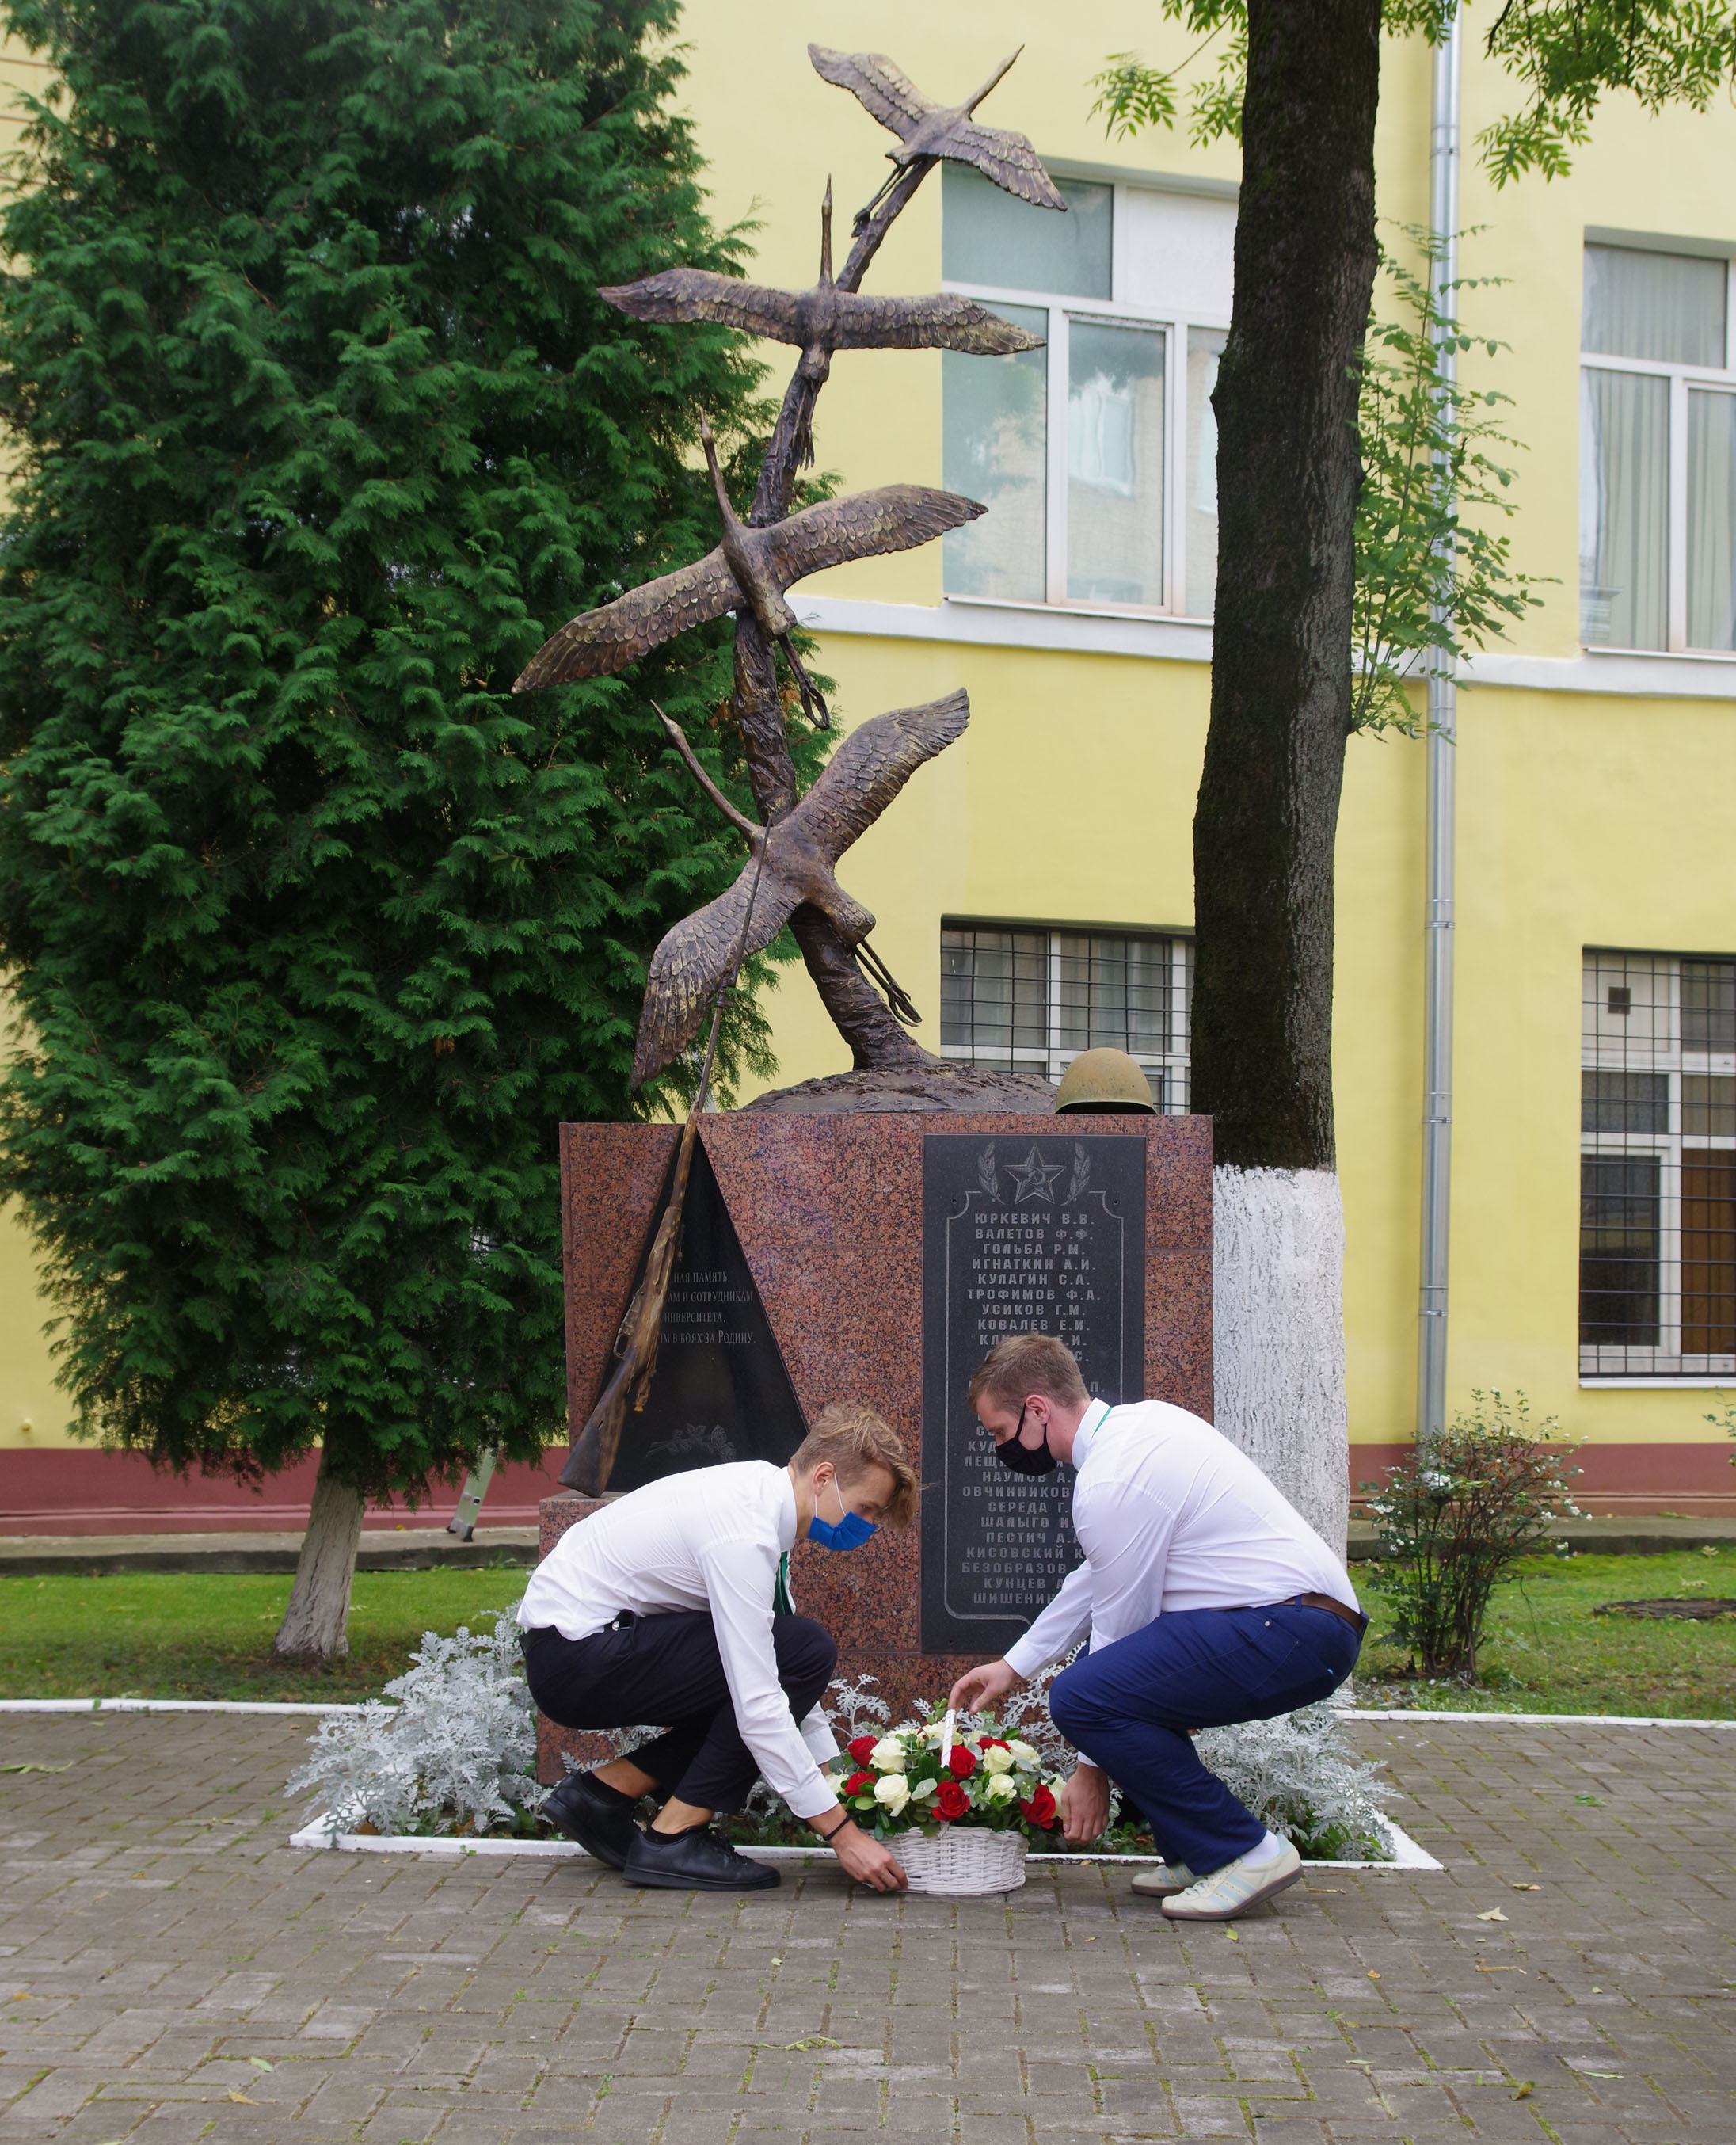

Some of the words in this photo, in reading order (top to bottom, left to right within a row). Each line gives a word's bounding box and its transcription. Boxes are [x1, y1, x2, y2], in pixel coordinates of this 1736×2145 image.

[975, 1213, 1051, 1224] ЮРКЕВИЧ
[1062, 1213, 1095, 1225] В.В.
[975, 1229, 1045, 1240] ВАЛЕТОВ
[1056, 1229, 1094, 1240] Ф.Ф.
[983, 1244, 1043, 1255] ГОЛЬБА
[1054, 1244, 1085, 1255] Р.М.
[973, 1259, 1053, 1269] ИГНАТКИН
[1064, 1259, 1096, 1270] А.И.
[692, 1271, 728, 1282] ПАМЯТЬ
[978, 1274, 1048, 1285] КУЛАГИН
[1059, 1274, 1091, 1285] С.А.
[691, 1290, 753, 1303] СОТРУДНИКАМ
[967, 1289, 1056, 1300] ТРОФИМОВ
[1066, 1289, 1101, 1301] Ф.А.
[982, 1304, 1045, 1315] УСИКОВ
[1056, 1304, 1086, 1316] Г.М.
[977, 1319, 1049, 1331] КОВАЛЕВ
[1059, 1320, 1091, 1331] Е.И.
[680, 1332, 702, 1343] БОЯХ
[704, 1332, 715, 1343] ЗА
[982, 1471, 1046, 1482] НАУМОВ
[962, 1486, 1070, 1498] ОВЧИННИКОВ
[988, 1502, 1048, 1514] СЕРЕДА
[981, 1517, 1049, 1528] ШАЛЫГО
[986, 1532, 1046, 1543] ПЕСТИЧ
[966, 1545, 1064, 1559] КИСОВСКИЙ
[961, 1562, 1067, 1574] БЕЗОБРАЗОВ
[984, 1577, 1046, 1590] КУНЦЕВ
